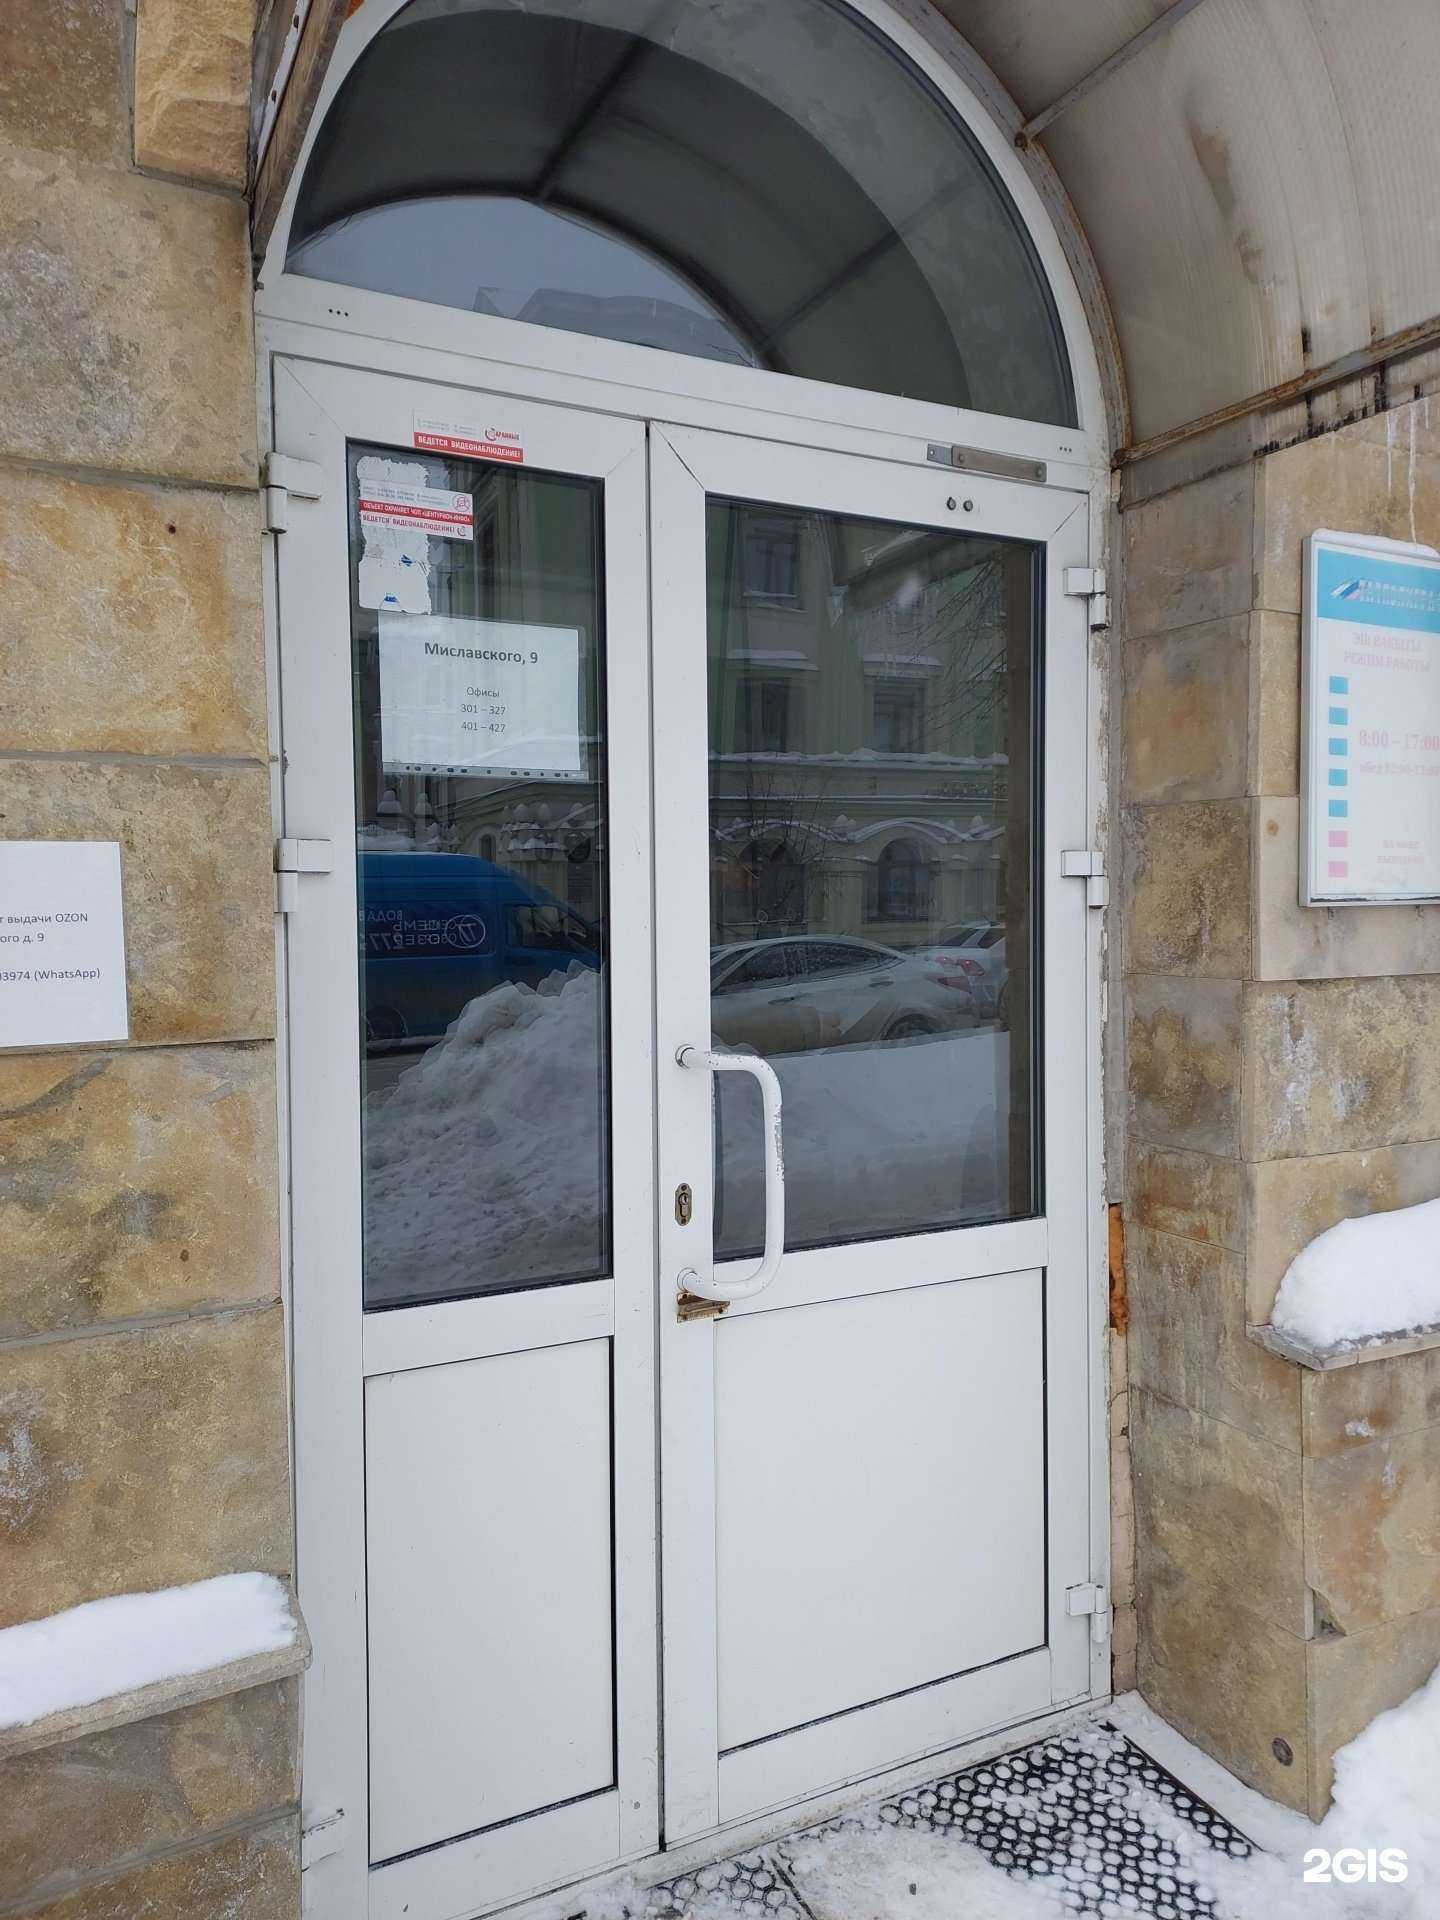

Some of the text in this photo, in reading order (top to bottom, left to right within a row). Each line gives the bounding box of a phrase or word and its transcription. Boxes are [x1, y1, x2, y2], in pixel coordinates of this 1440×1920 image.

[418, 435, 521, 457] ВЕДЕТСЯ ВИДЕОНАБЛЮДЕНИЕ!
[362, 514, 455, 533] ВЕДЕТСЯ ВИДЕОНАБЛЮДЕНИЕ!
[424, 641, 539, 666] Миславского, 9
[466, 686, 500, 698] Офисы
[461, 703, 478, 714] 301
[488, 705, 506, 716] 327
[461, 721, 478, 731] 401
[488, 723, 506, 733] 427
[1359, 729, 1389, 748] 8:00
[1404, 732, 1440, 751] 17:00
[7, 915, 52, 925] выдачи
[55, 913, 88, 923] OZON
[22, 935, 34, 944] д.
[37, 932, 45, 942] 9
[34, 967, 101, 982] (WhatsApp)
